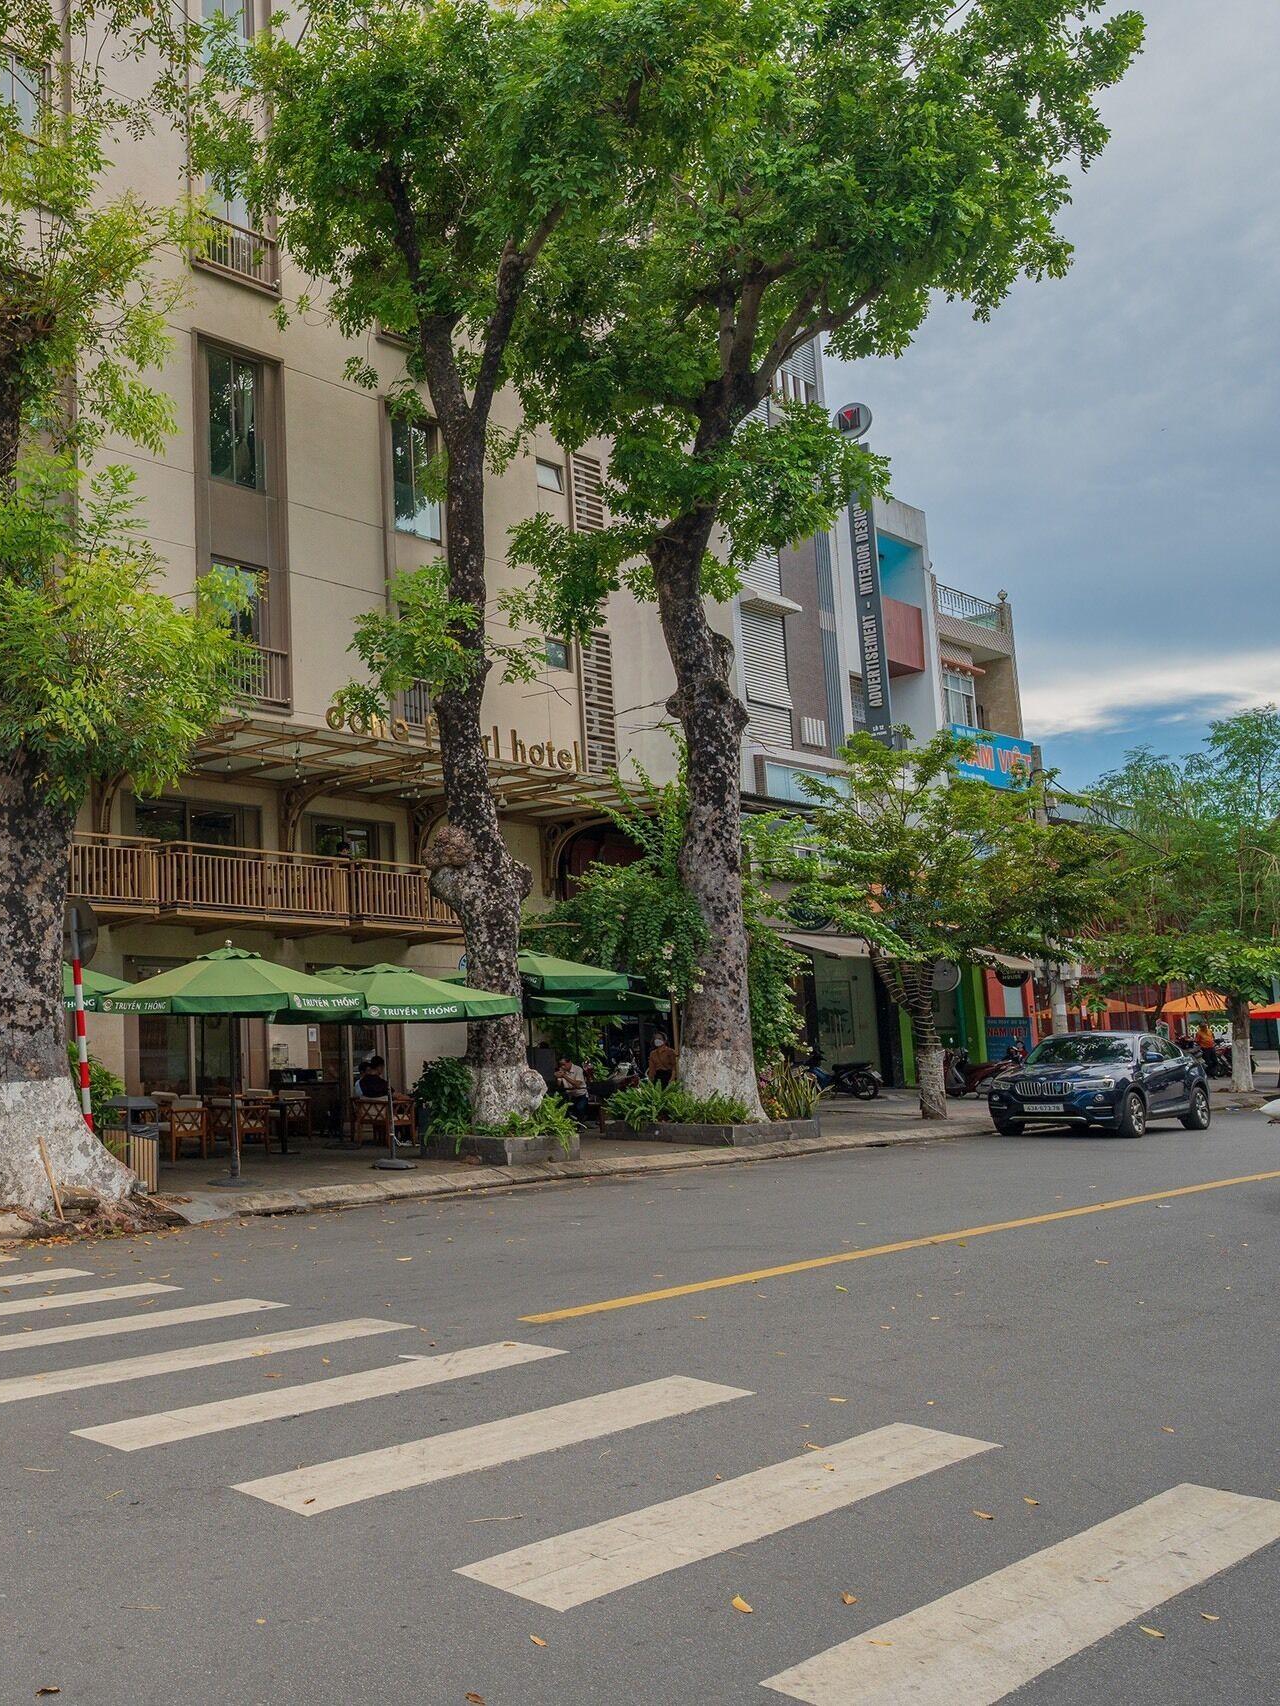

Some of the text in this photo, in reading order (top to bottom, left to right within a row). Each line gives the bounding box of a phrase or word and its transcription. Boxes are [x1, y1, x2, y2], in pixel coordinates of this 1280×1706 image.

[857, 544, 873, 595] INTERIOR
[863, 614, 883, 707] ADVERTISEMENT
[511, 729, 580, 773] hotel
